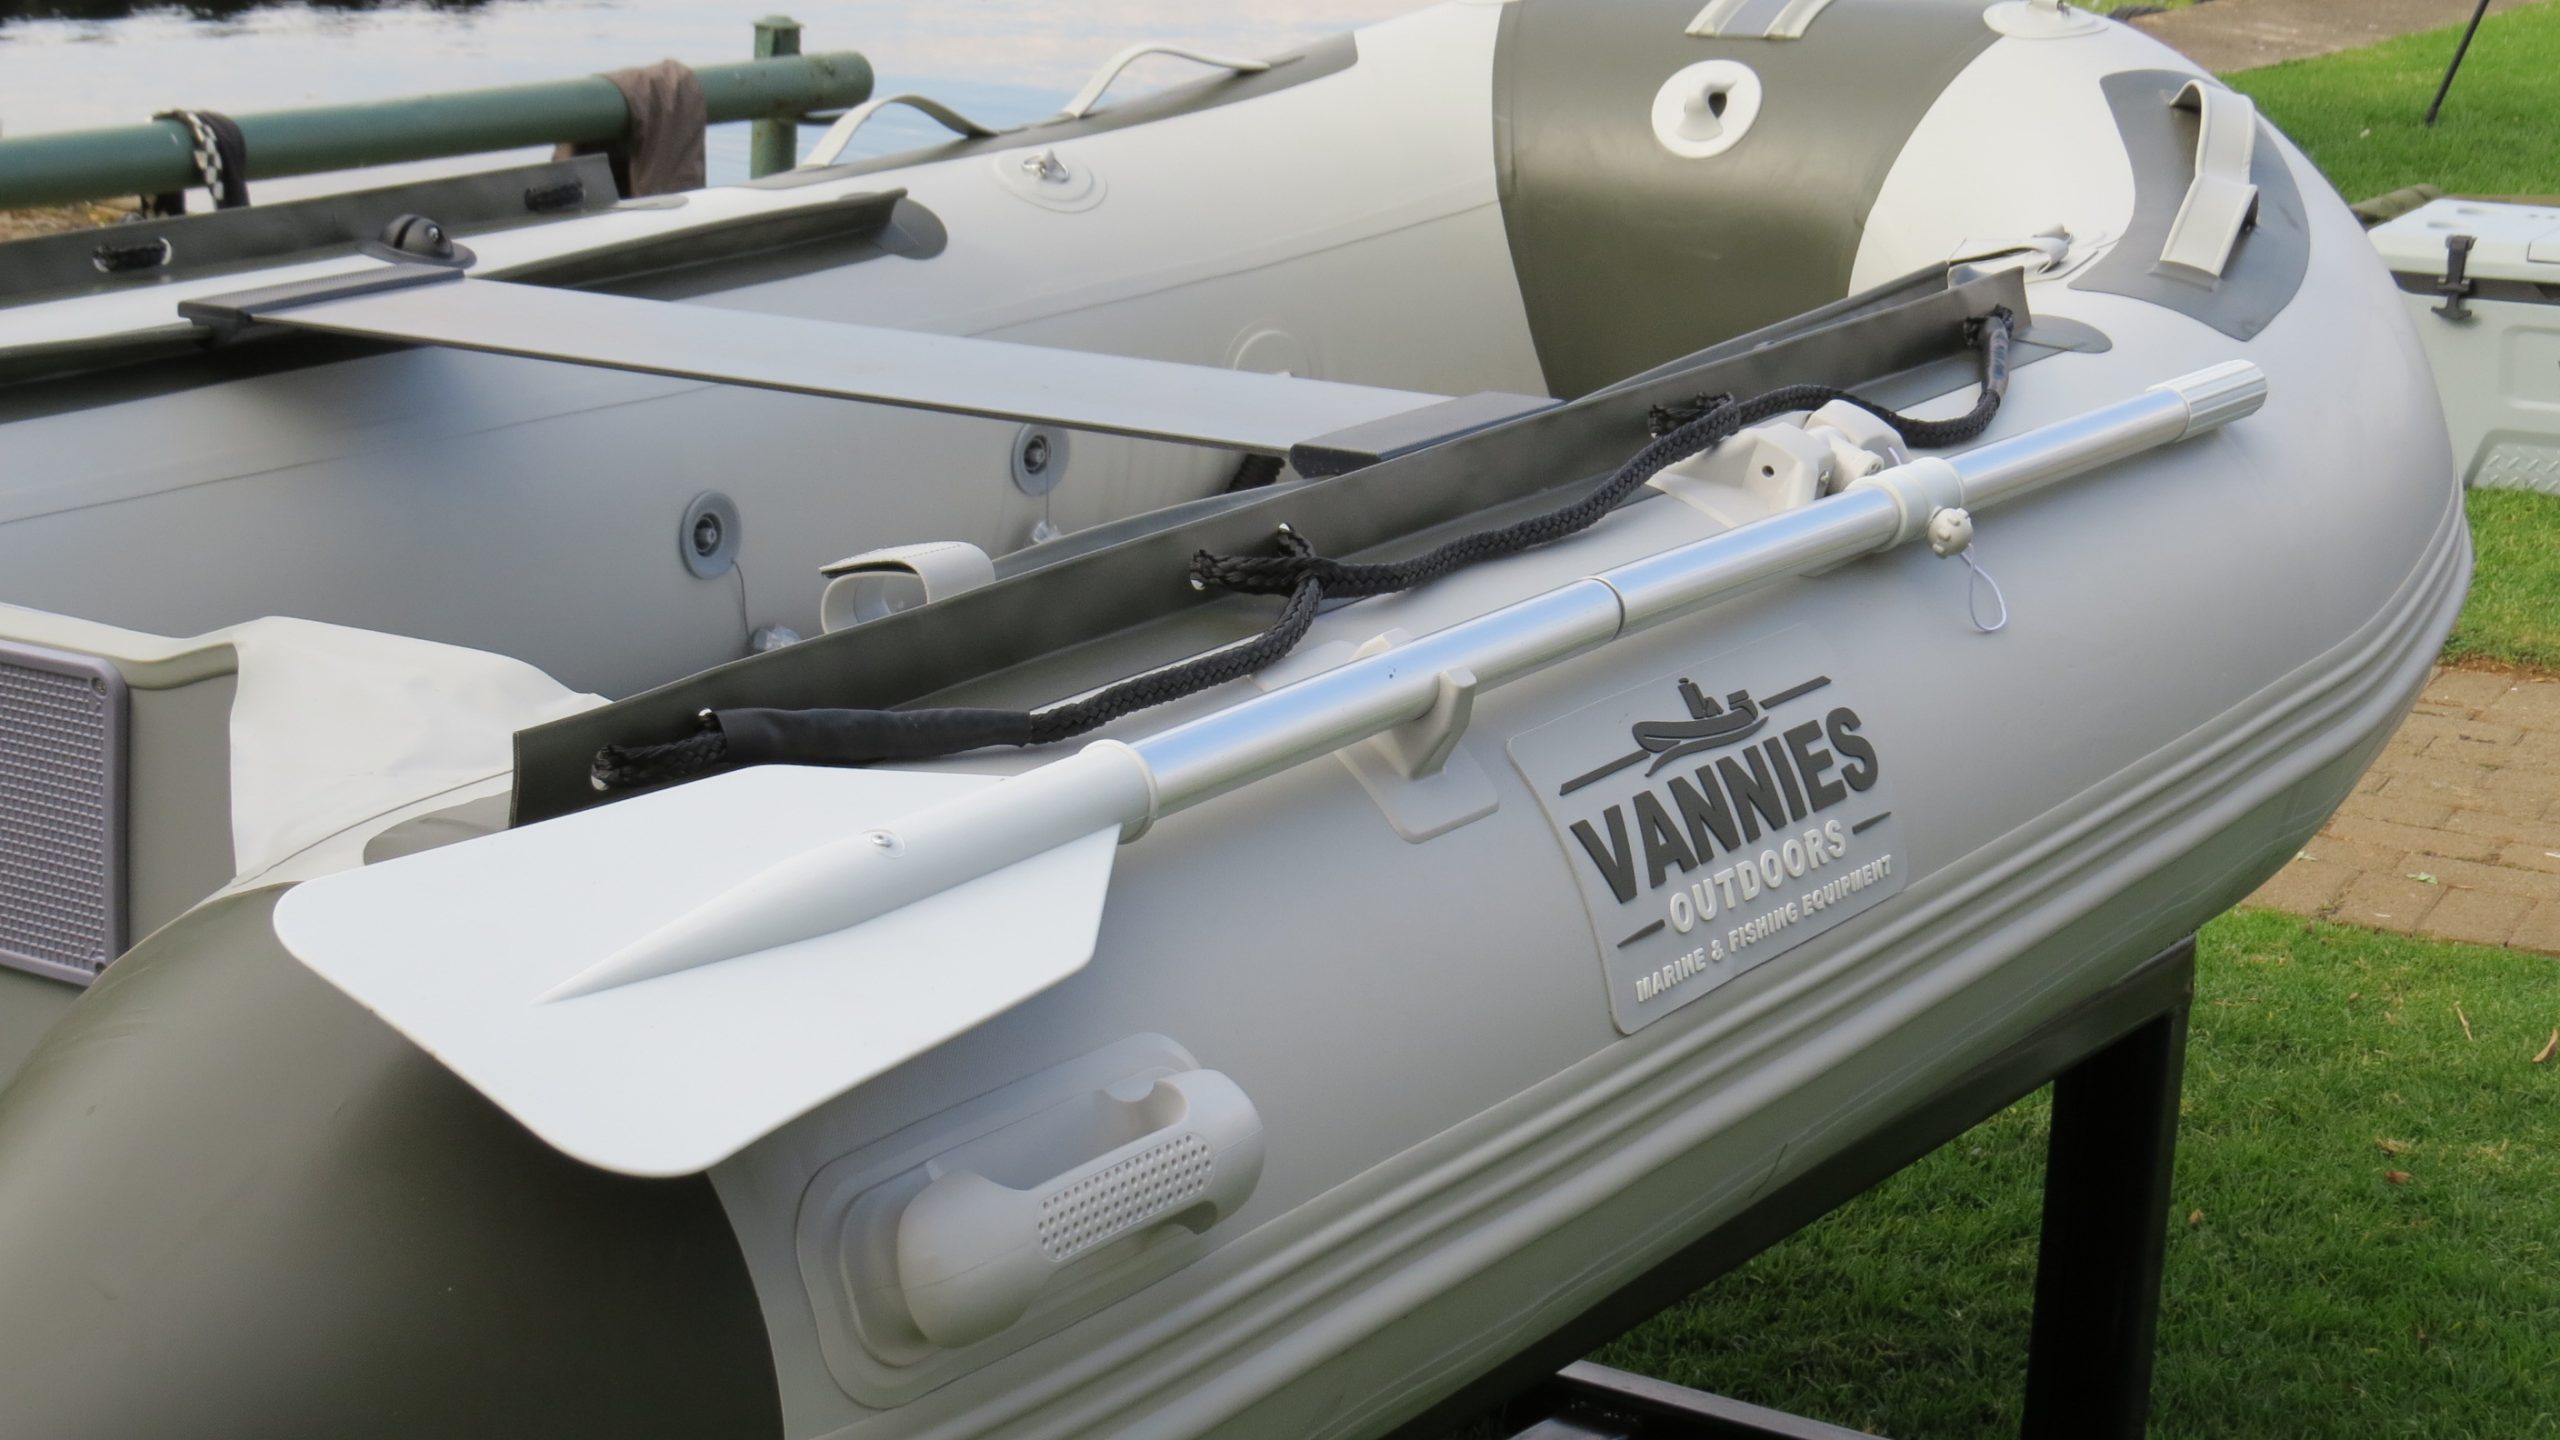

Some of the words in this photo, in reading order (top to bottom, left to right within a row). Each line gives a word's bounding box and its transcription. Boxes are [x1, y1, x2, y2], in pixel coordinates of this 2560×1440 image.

[1569, 706, 1879, 904] VANNIES
[1669, 819, 1847, 933] OUTDOORS
[1635, 947, 1707, 1002] MARINE
[1711, 939, 1725, 961] &
[1728, 902, 1799, 952] FISHING
[1801, 854, 1893, 918] EQUIPMENT
